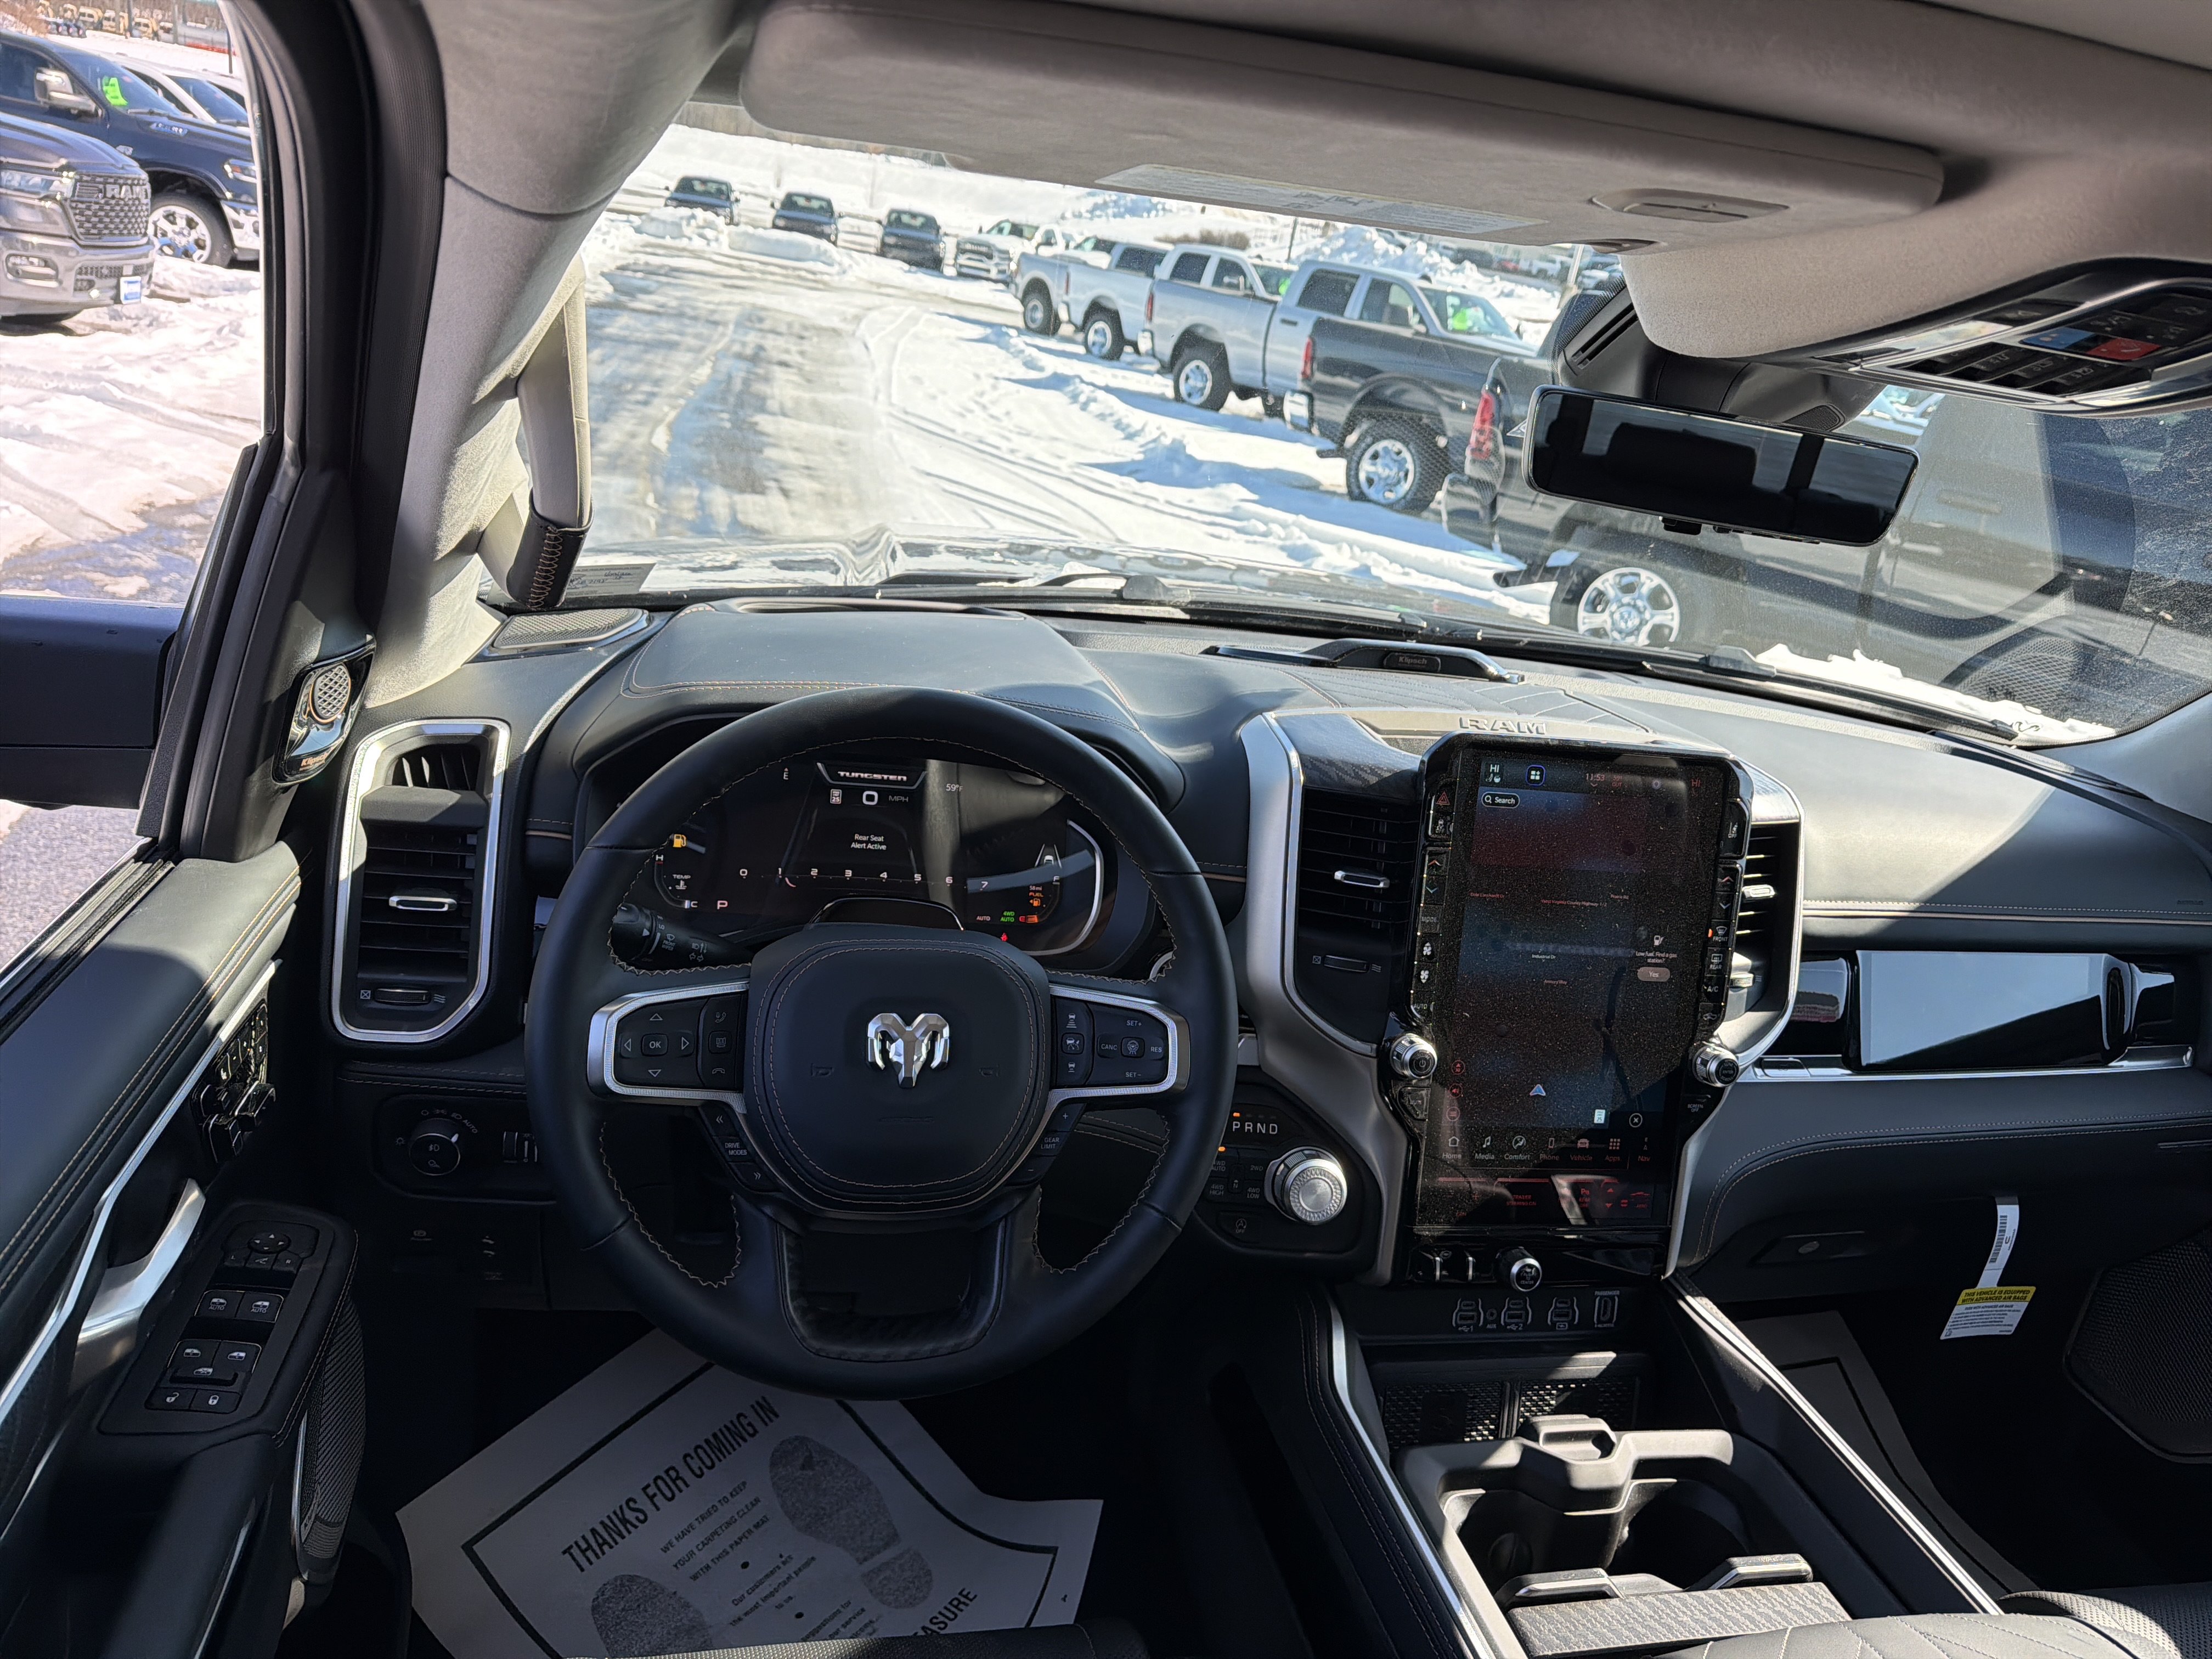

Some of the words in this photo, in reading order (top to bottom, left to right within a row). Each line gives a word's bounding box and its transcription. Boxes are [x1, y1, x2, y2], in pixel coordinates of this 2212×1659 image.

[106, 184, 151, 199] RAM
[1398, 655, 1427, 665] Klipsch
[1459, 717, 1546, 735] RAM
[301, 752, 328, 766] Klipsch
[1489, 764, 1499, 773] HI
[838, 771, 907, 781] TUNGSTEN
[1585, 773, 1605, 781] 11:53
[854, 833, 869, 842] Rear
[717, 900, 729, 910] P
[649, 1041, 662, 1049] OK
[462, 1119, 478, 1133] AUTO
[1233, 1121, 1240, 1132] P
[1245, 1122, 1253, 1133] R
[1257, 1123, 1266, 1133] N
[1269, 1124, 1278, 1135] D
[561, 1497, 648, 1573] THANKS
[641, 1465, 690, 1511] FOR
[682, 1412, 759, 1479] COMING
[751, 1396, 780, 1426] IN
[660, 1539, 675, 1554] WE
[674, 1522, 697, 1543] HAVE
[695, 1504, 719, 1525] TRIED
[717, 1496, 730, 1506] TO
[730, 1481, 747, 1498] KEEP
[672, 1549, 696, 1571] YOUR
[696, 1515, 737, 1552] CARPETING
[736, 1496, 761, 1519] CLEAN
[689, 1563, 712, 1582] WITH
[711, 1548, 730, 1565] THIS
[729, 1528, 754, 1551] PAPER
[753, 1515, 769, 1530] MAT
[731, 1593, 746, 1606] Our
[746, 1565, 781, 1595] customers
[760, 1573, 795, 1603] important
[913, 1587, 978, 1636] ASURE
